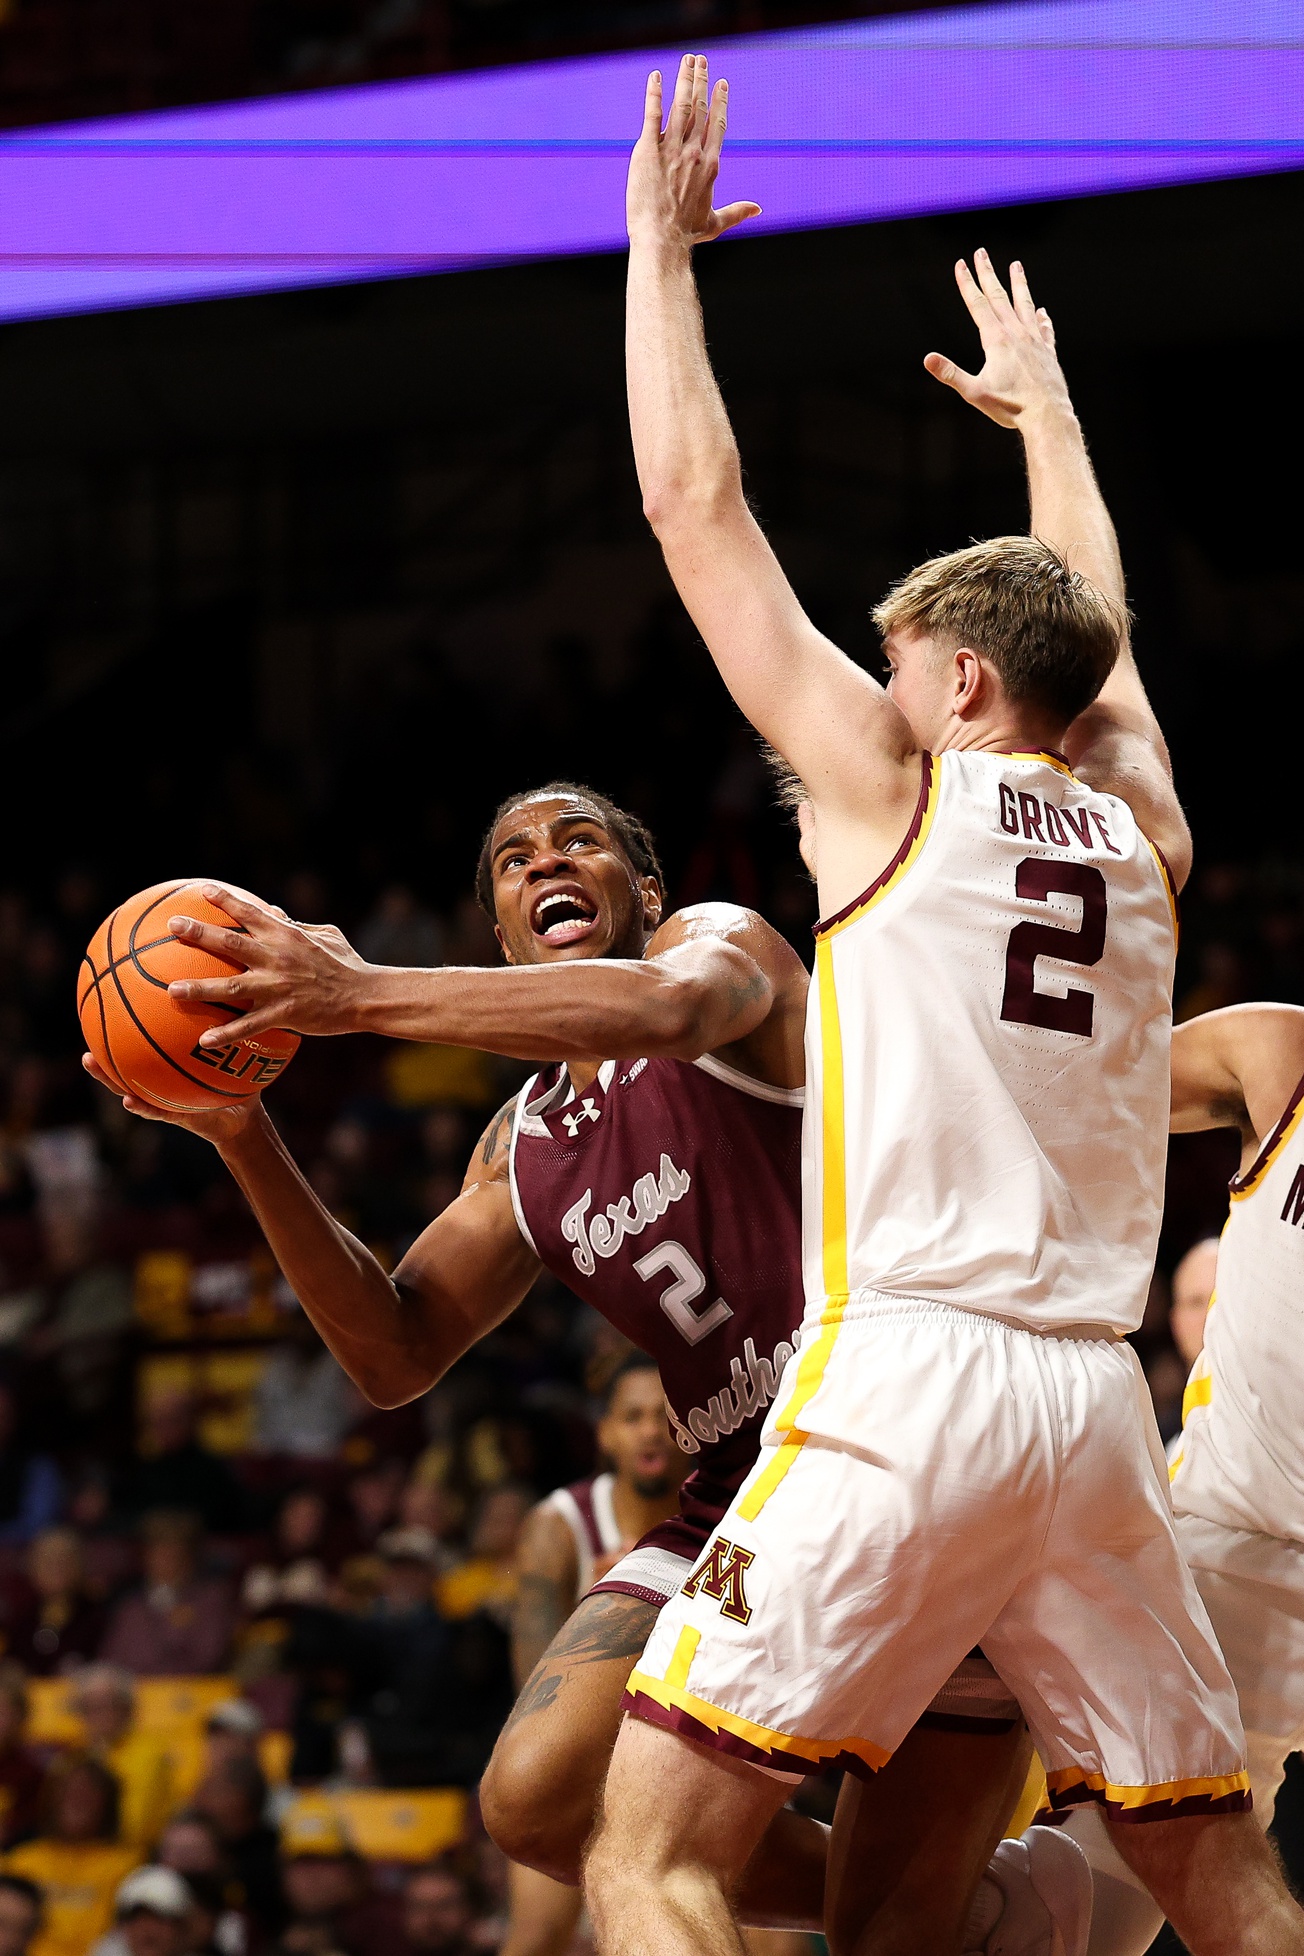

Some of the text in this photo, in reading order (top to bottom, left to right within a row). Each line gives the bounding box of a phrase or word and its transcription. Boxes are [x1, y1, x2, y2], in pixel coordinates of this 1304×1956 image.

[1000, 782, 1122, 855] GROVE
[1001, 857, 1107, 1037] 2
[190, 1043, 287, 1084] ELITE
[561, 1153, 691, 1276] Texas
[633, 1240, 734, 1346] 2
[681, 1536, 756, 1626] M
